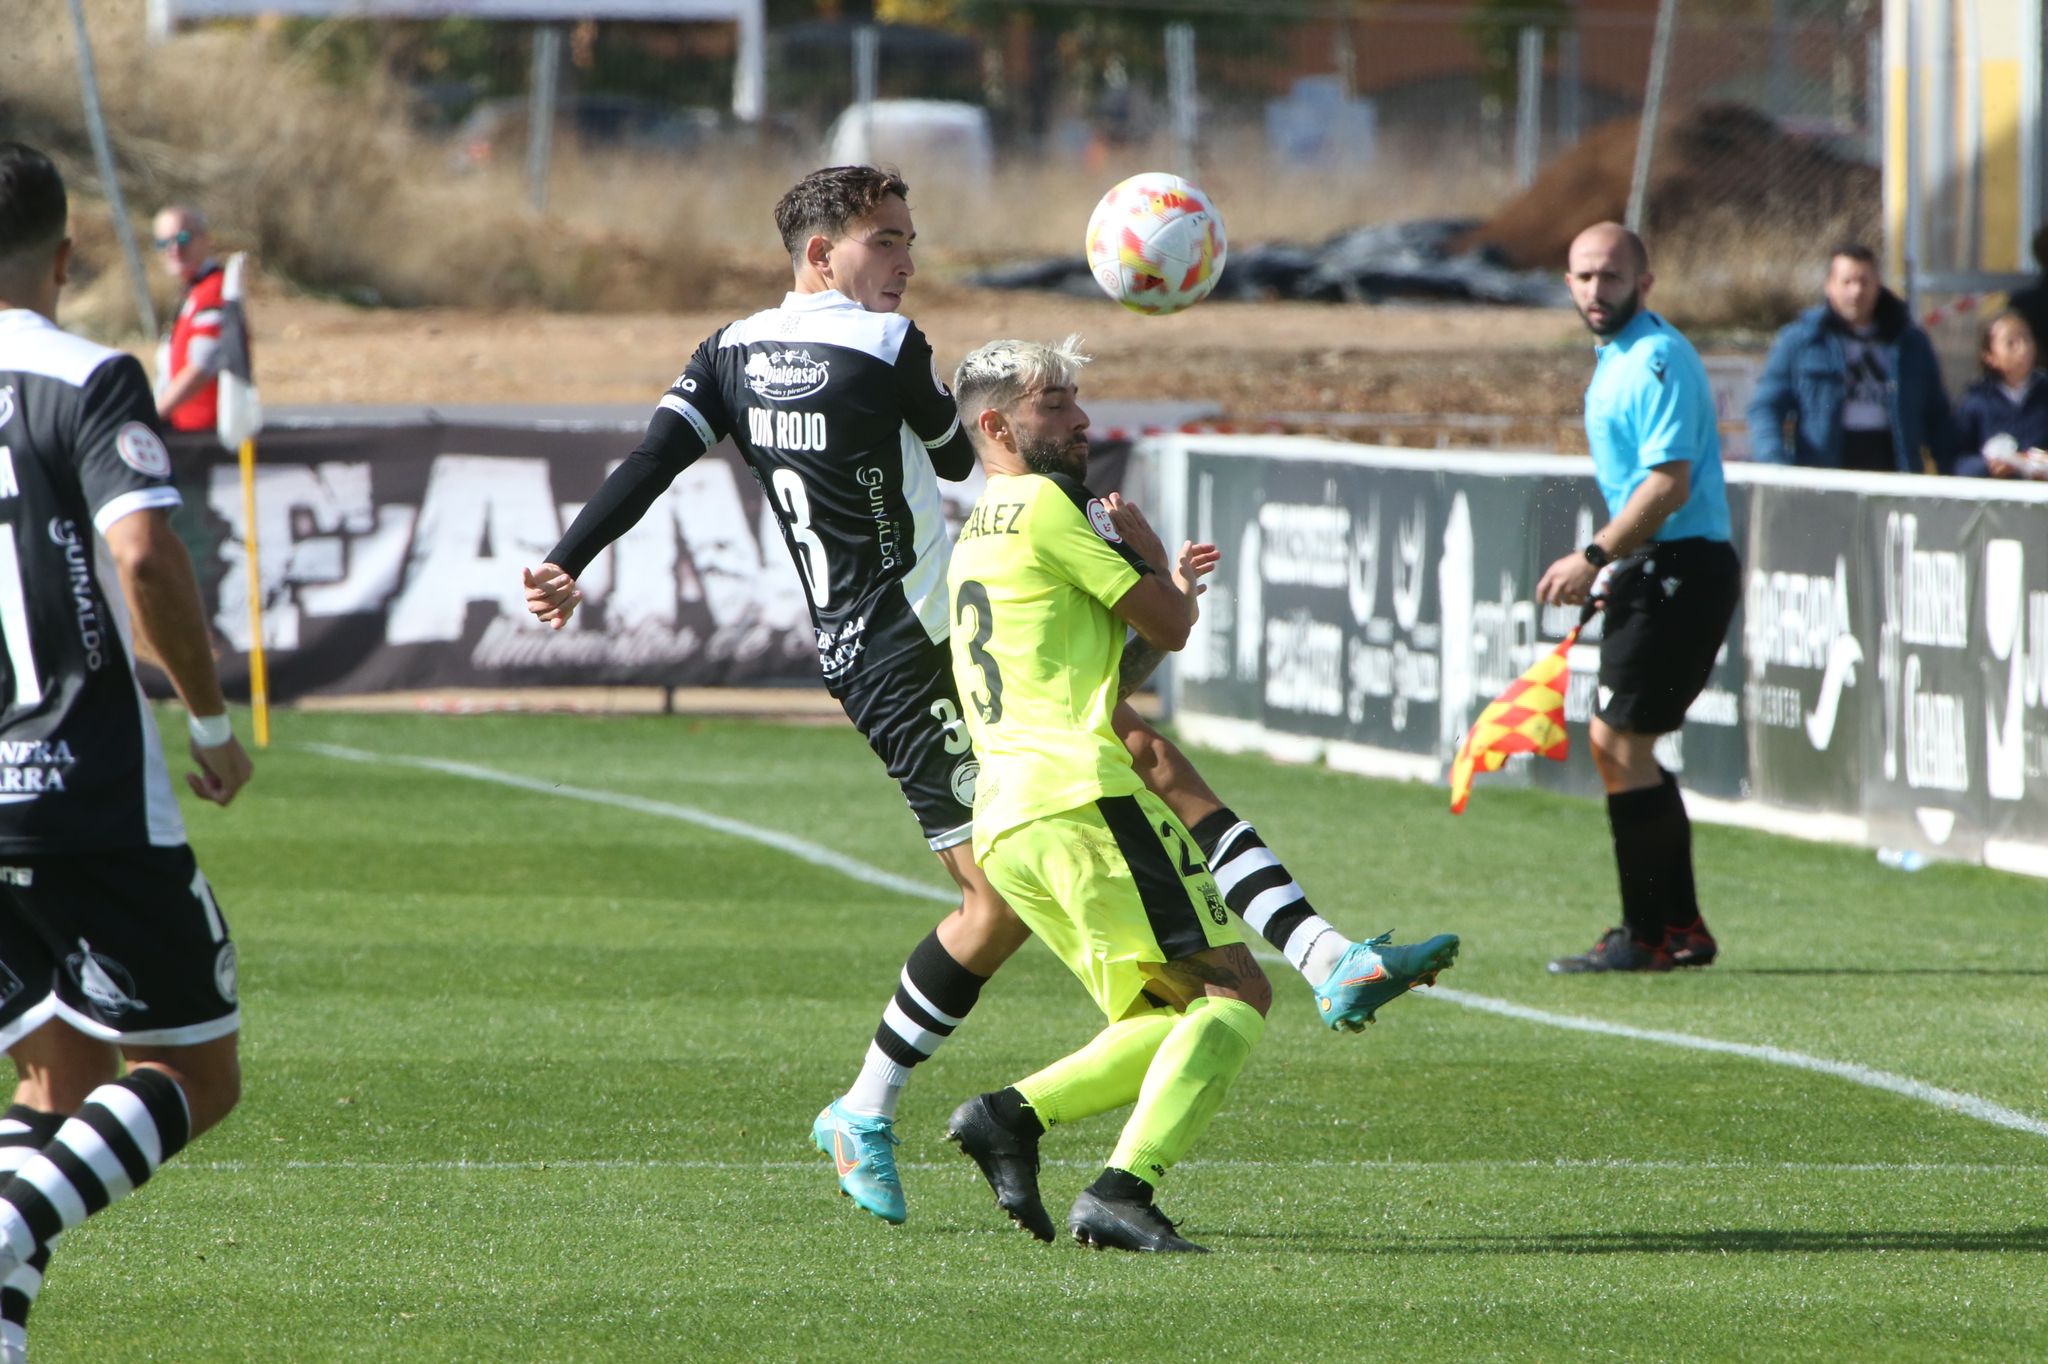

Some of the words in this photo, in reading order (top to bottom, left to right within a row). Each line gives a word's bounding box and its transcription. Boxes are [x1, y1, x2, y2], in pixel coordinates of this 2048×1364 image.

[748, 407, 774, 448] JON
[776, 411, 827, 452] ROJO
[772, 467, 829, 609] 3
[856, 465, 895, 569] GUINALDO
[48, 517, 102, 671] GUINALDO
[956, 579, 1004, 725] 3
[930, 698, 972, 755] 3
